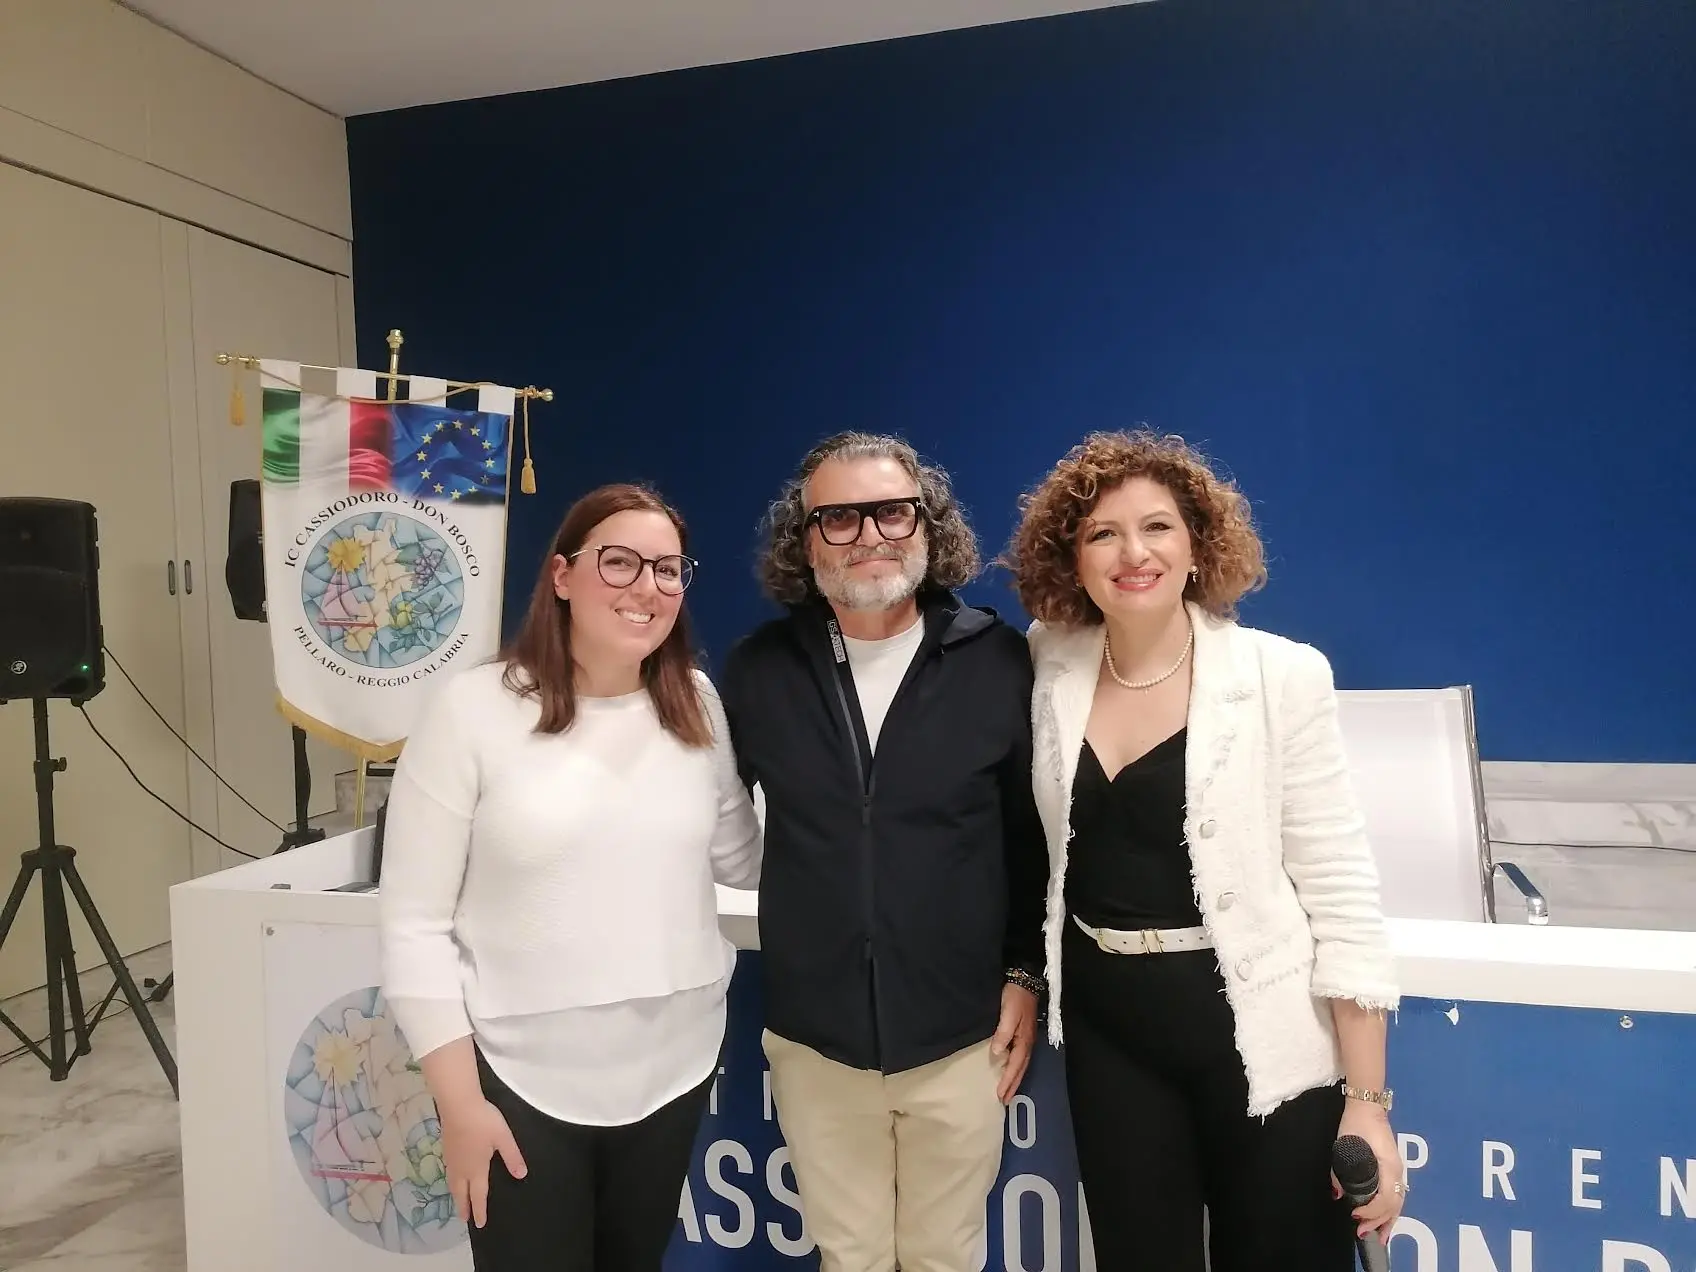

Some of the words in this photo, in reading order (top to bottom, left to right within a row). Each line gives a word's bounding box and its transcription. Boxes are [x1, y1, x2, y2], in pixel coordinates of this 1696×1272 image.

[284, 547, 299, 568] IC
[295, 492, 398, 545] CASSIODORO
[413, 500, 448, 525] DON
[448, 525, 480, 577] BOSCO
[294, 626, 346, 676] PELLARO
[357, 675, 410, 687] REGGIO
[413, 632, 469, 680] CALABRIA
